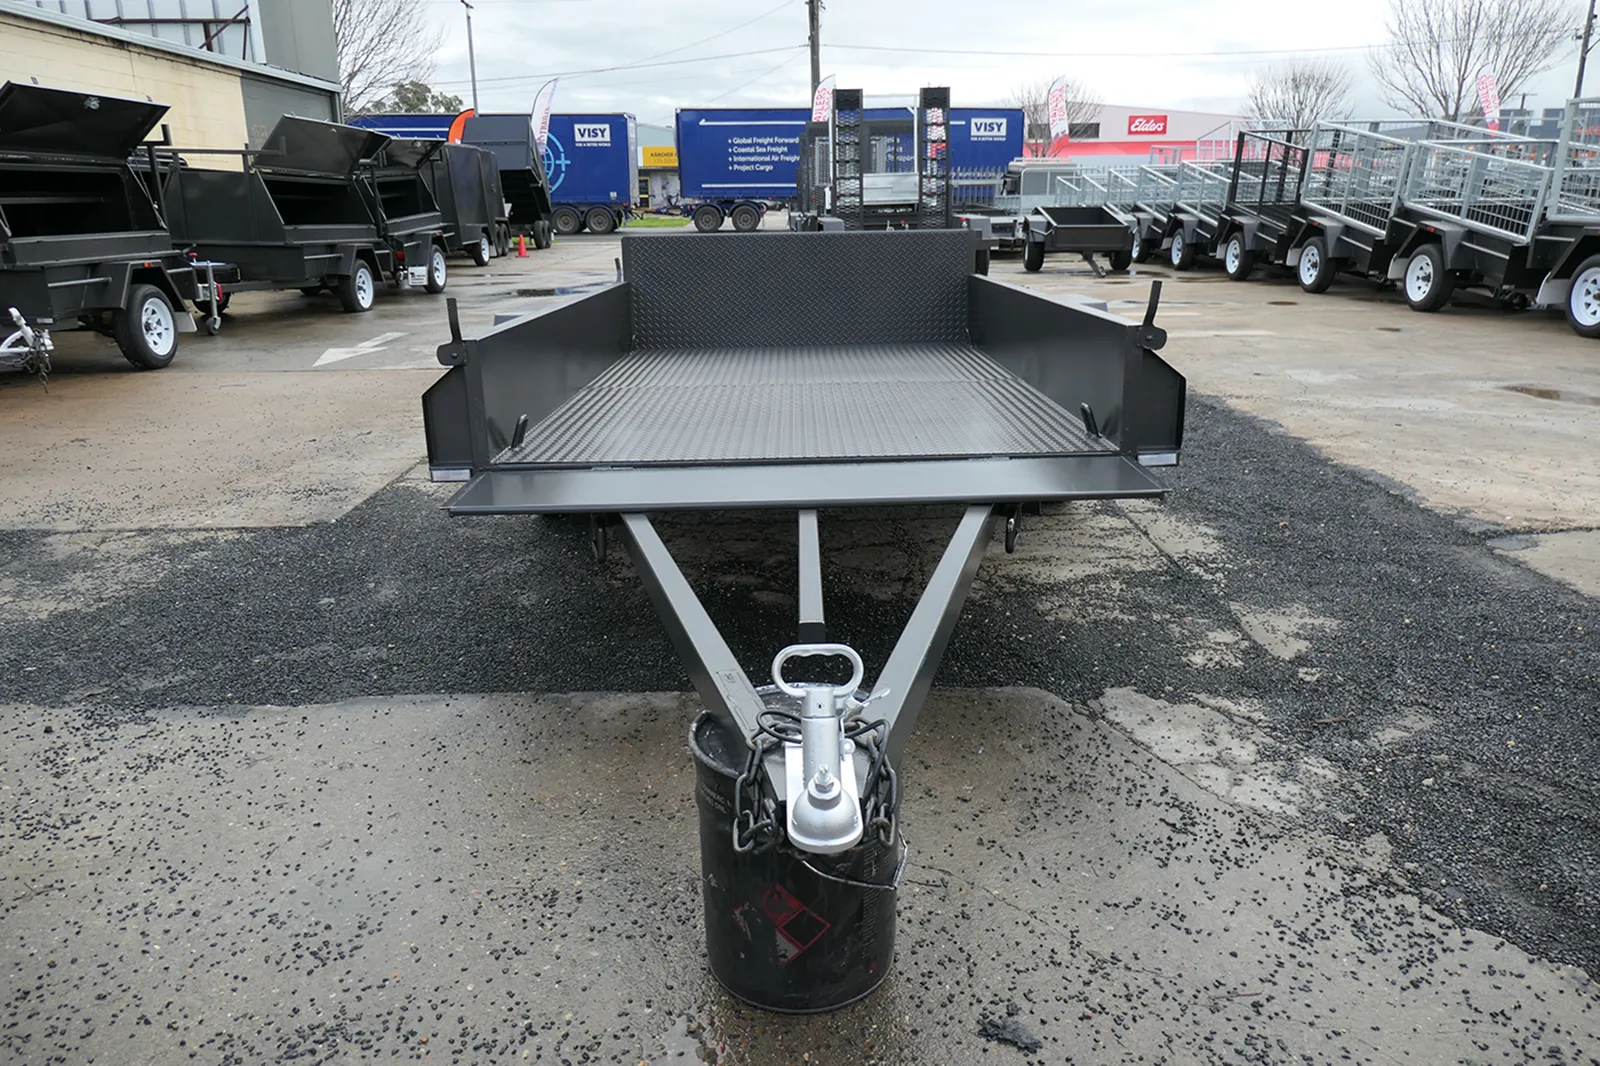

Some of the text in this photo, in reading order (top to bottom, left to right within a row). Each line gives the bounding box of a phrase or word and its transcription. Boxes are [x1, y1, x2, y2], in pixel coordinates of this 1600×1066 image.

[974, 122, 1003, 132] VISY
[1130, 118, 1164, 132] Elders
[578, 128, 606, 138] VISY
[753, 137, 773, 145] Freight
